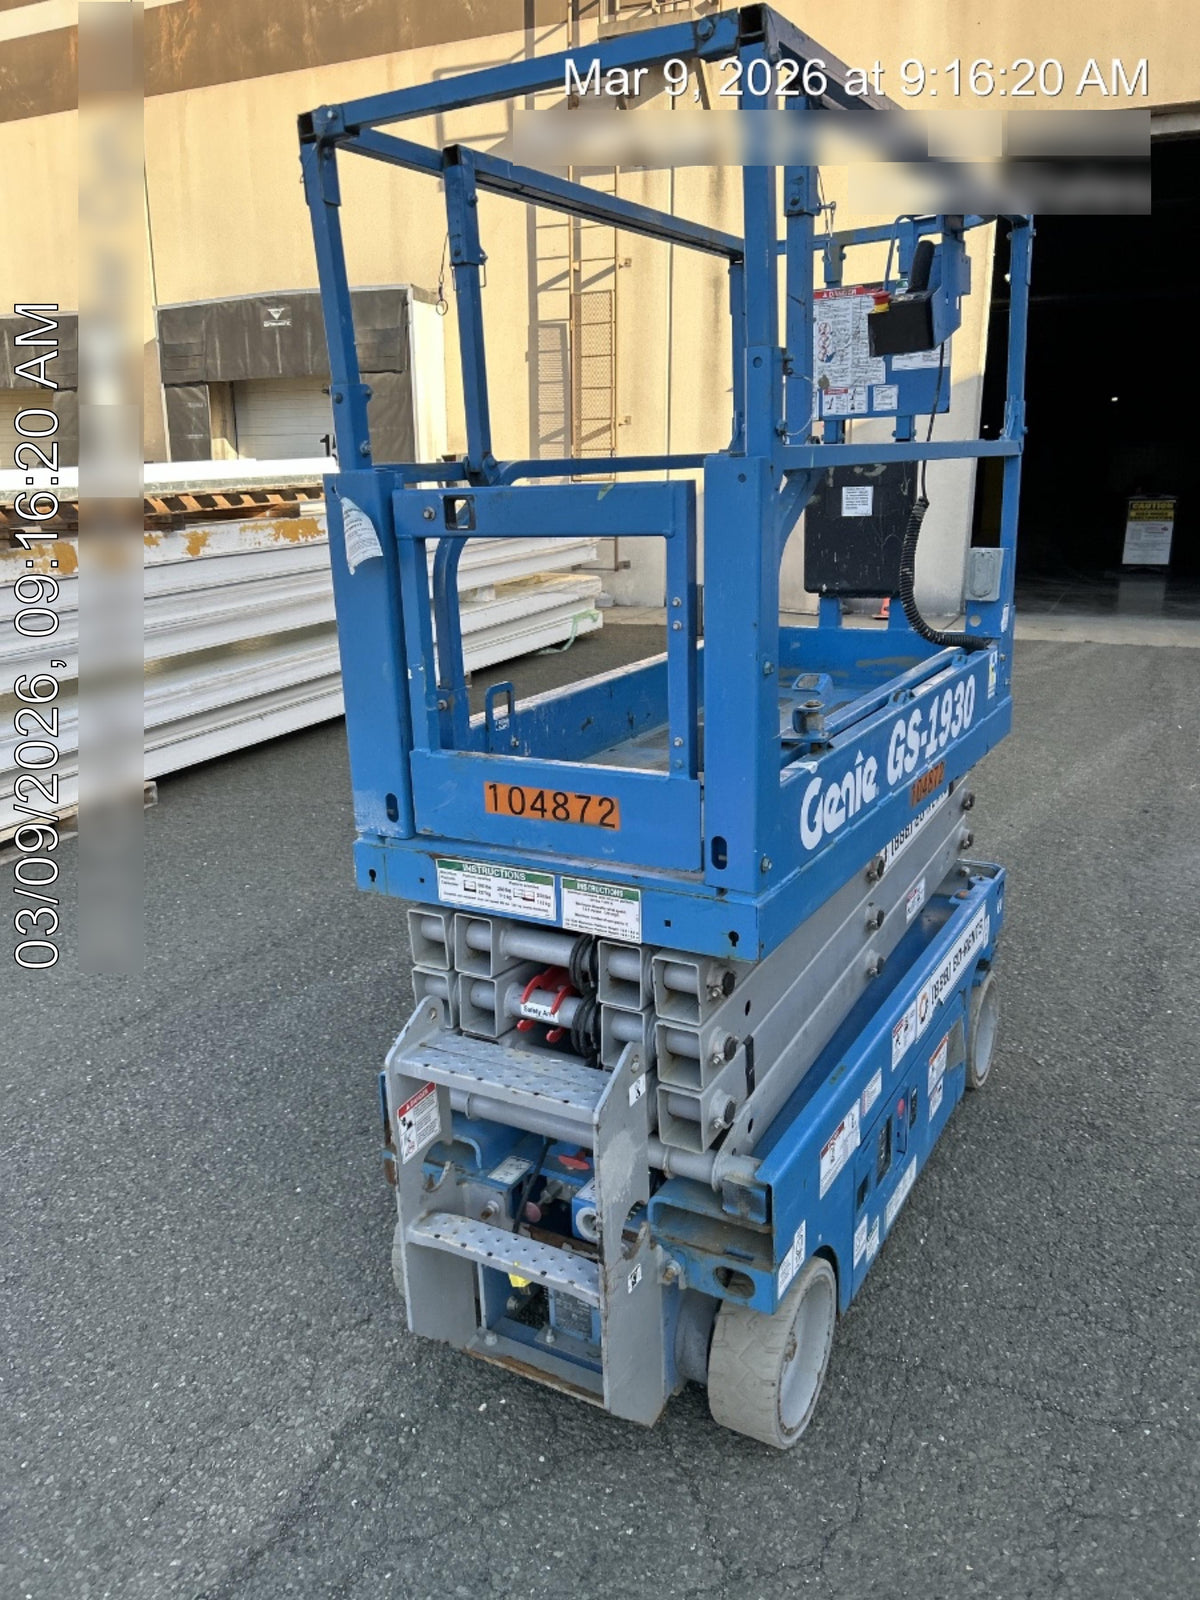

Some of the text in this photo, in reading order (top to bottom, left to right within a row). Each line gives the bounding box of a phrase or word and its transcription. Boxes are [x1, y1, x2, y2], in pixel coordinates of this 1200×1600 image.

[801, 674, 976, 850] Genie GS-1930
[488, 783, 616, 829] 104872
[462, 864, 527, 881] INSTRUCTIONS
[576, 882, 624, 898] INSTRUCTIONS
